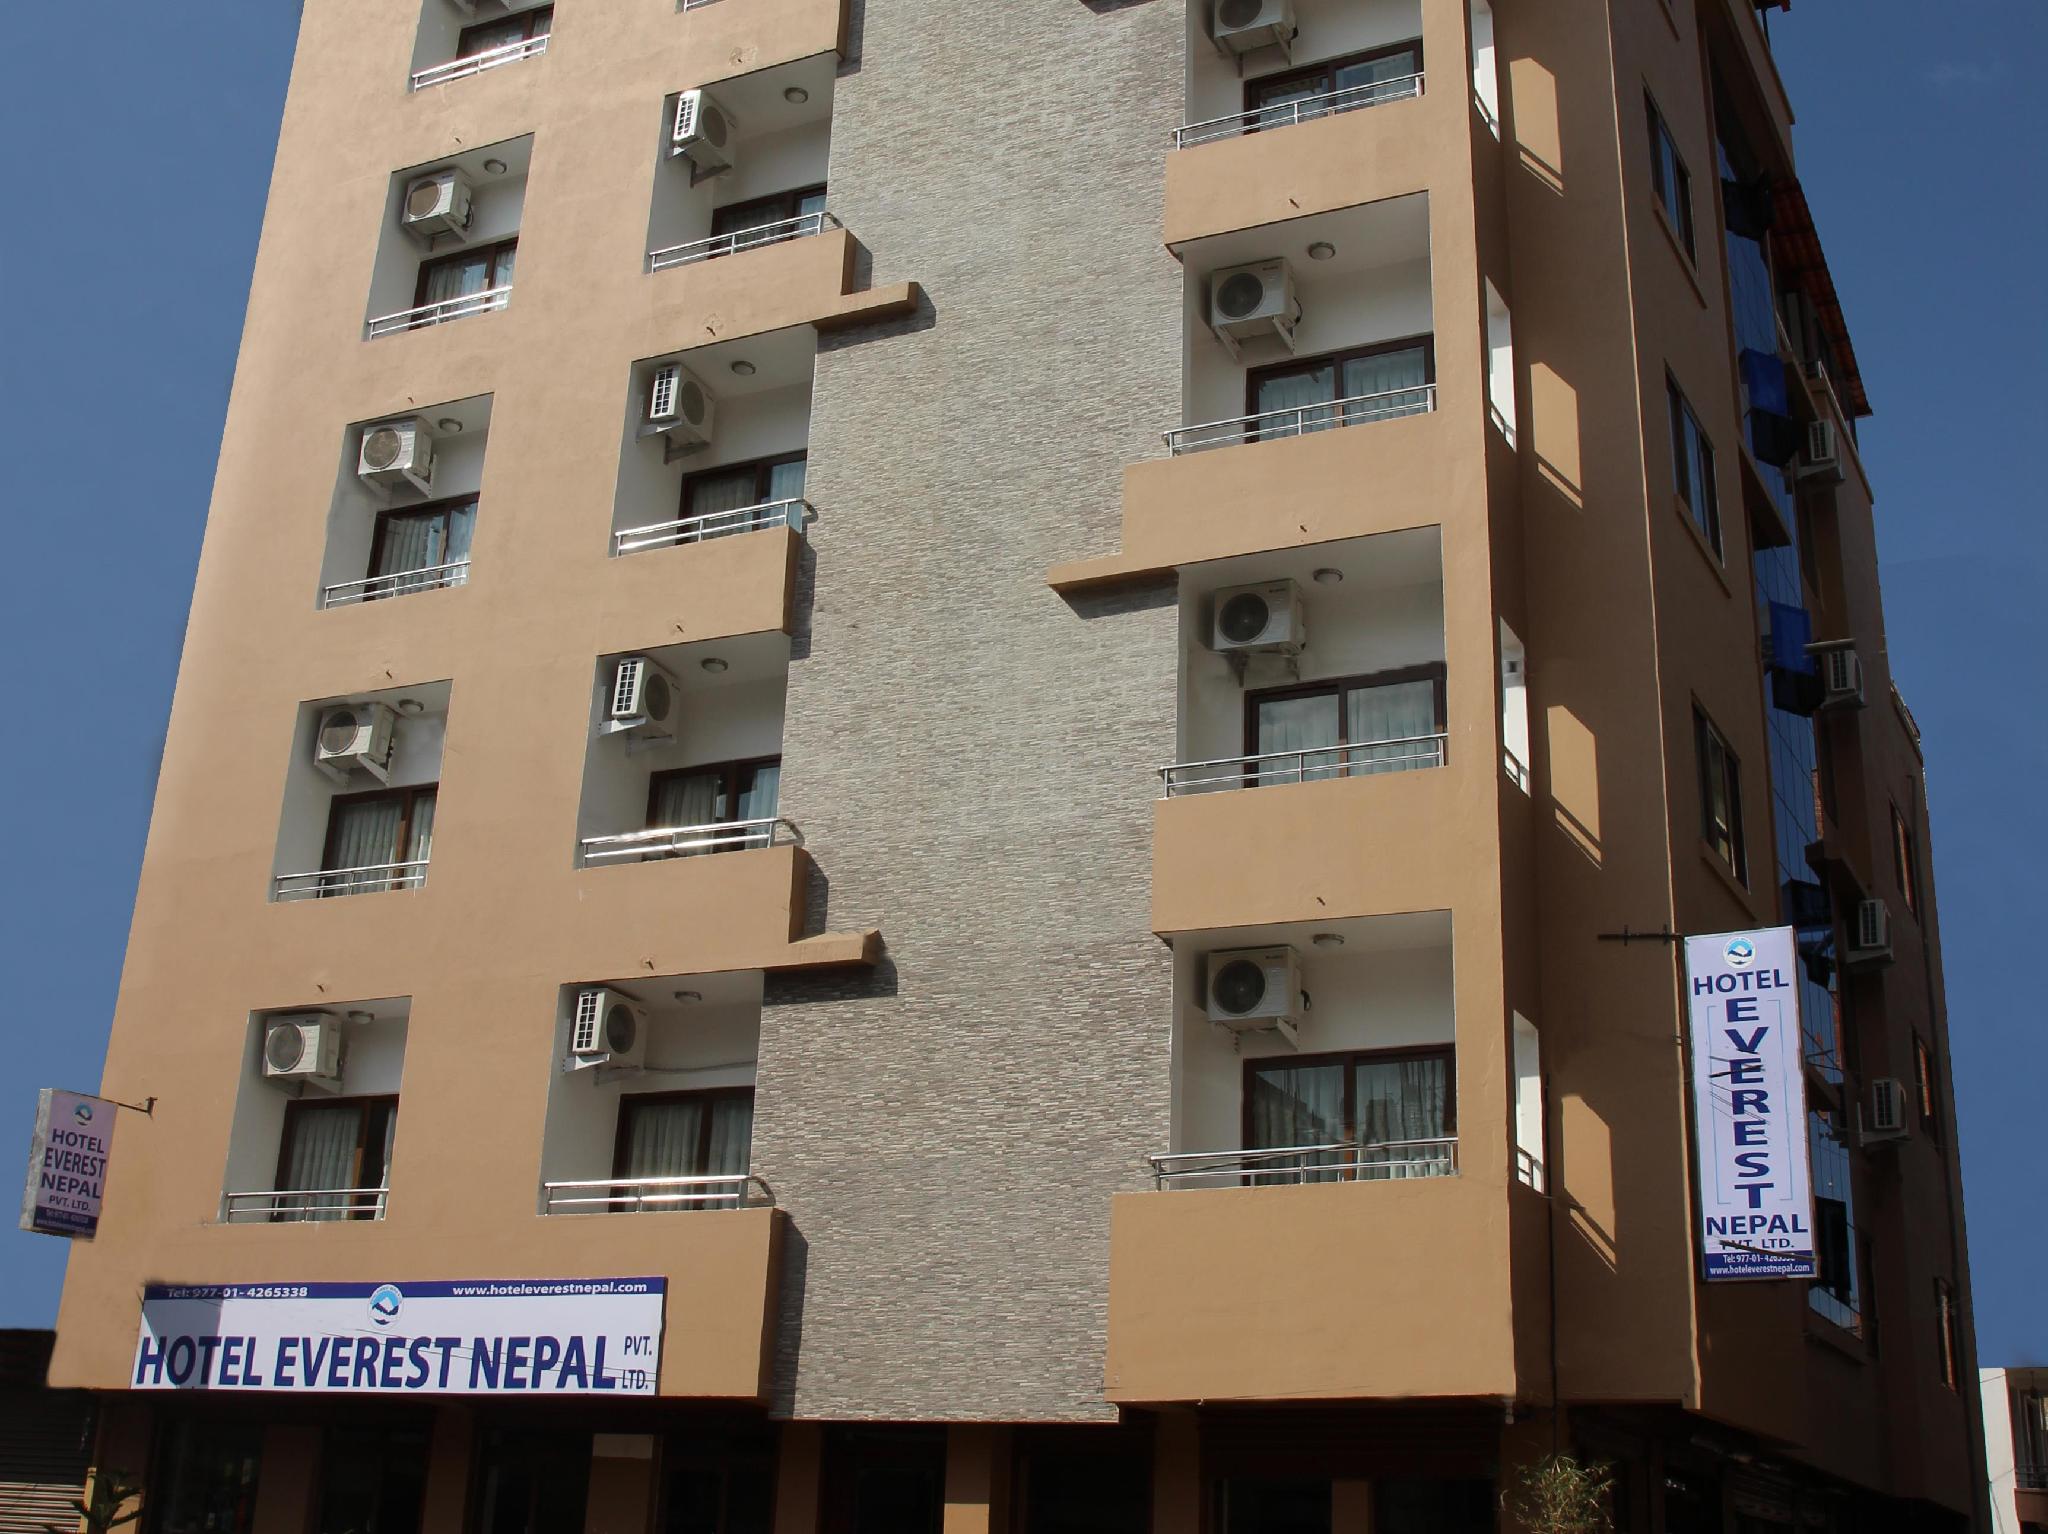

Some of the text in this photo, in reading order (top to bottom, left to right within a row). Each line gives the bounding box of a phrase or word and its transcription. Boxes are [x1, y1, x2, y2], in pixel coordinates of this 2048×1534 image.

[1694, 969, 1789, 995] HOTEL
[1724, 997, 1774, 1209] EVEREST
[52, 1128, 104, 1154] HOTEL
[44, 1147, 106, 1178] EVEREST
[40, 1172, 100, 1199] NEPAL
[49, 1195, 91, 1212] PVT. LTD.
[1706, 1214, 1808, 1235] NEPAL
[1761, 1238, 1795, 1249] LTD.
[1710, 1263, 1810, 1275] www.hoteleverestnepal.com
[168, 1288, 190, 1298] Tel:
[452, 1281, 648, 1296] www.hoteleverestnepal.com
[623, 1335, 653, 1356] PVT.
[136, 1335, 616, 1389] HOTEL EVEREST NEPAL
[621, 1369, 649, 1390] LTD.
